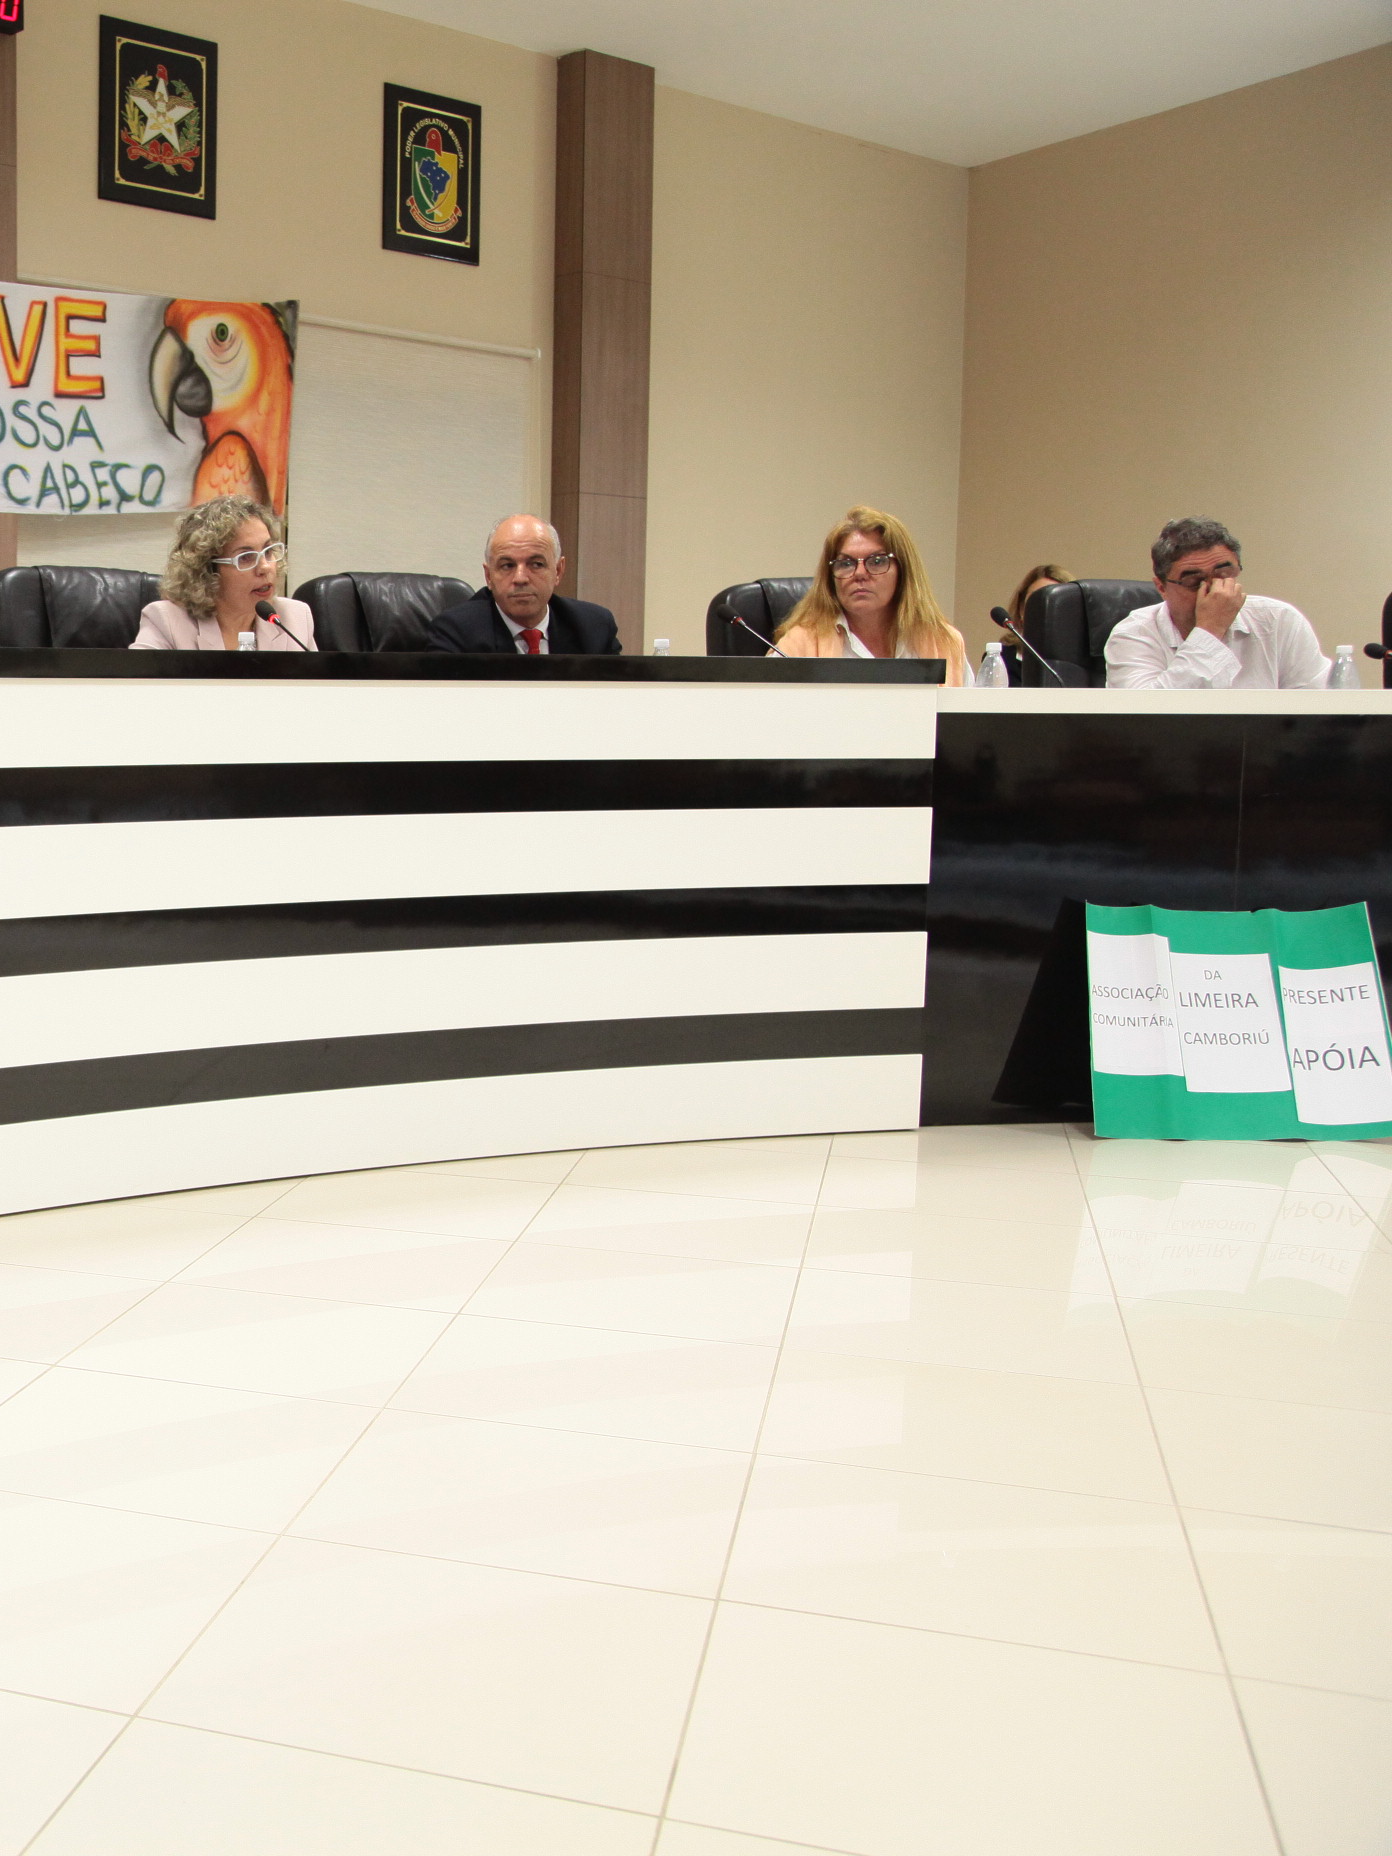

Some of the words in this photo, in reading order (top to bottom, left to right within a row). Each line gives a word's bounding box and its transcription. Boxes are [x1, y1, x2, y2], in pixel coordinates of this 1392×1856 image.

[405, 130, 416, 157] PODER
[413, 118, 449, 132] LEGISLATIVO
[448, 128, 464, 168] MUNICIPAL
[3, 460, 165, 514] CABEÇO
[1204, 970, 1222, 981] DA
[1091, 984, 1169, 1002] ASSOCIAÇÃO
[1179, 991, 1259, 1009] LIMEIRA
[1283, 984, 1371, 1006] PRESENTE
[1093, 1012, 1174, 1028] COMUNITÁRIA
[1183, 1028, 1270, 1046] CAMBORIÚ
[1292, 1043, 1381, 1071] APÓIA
